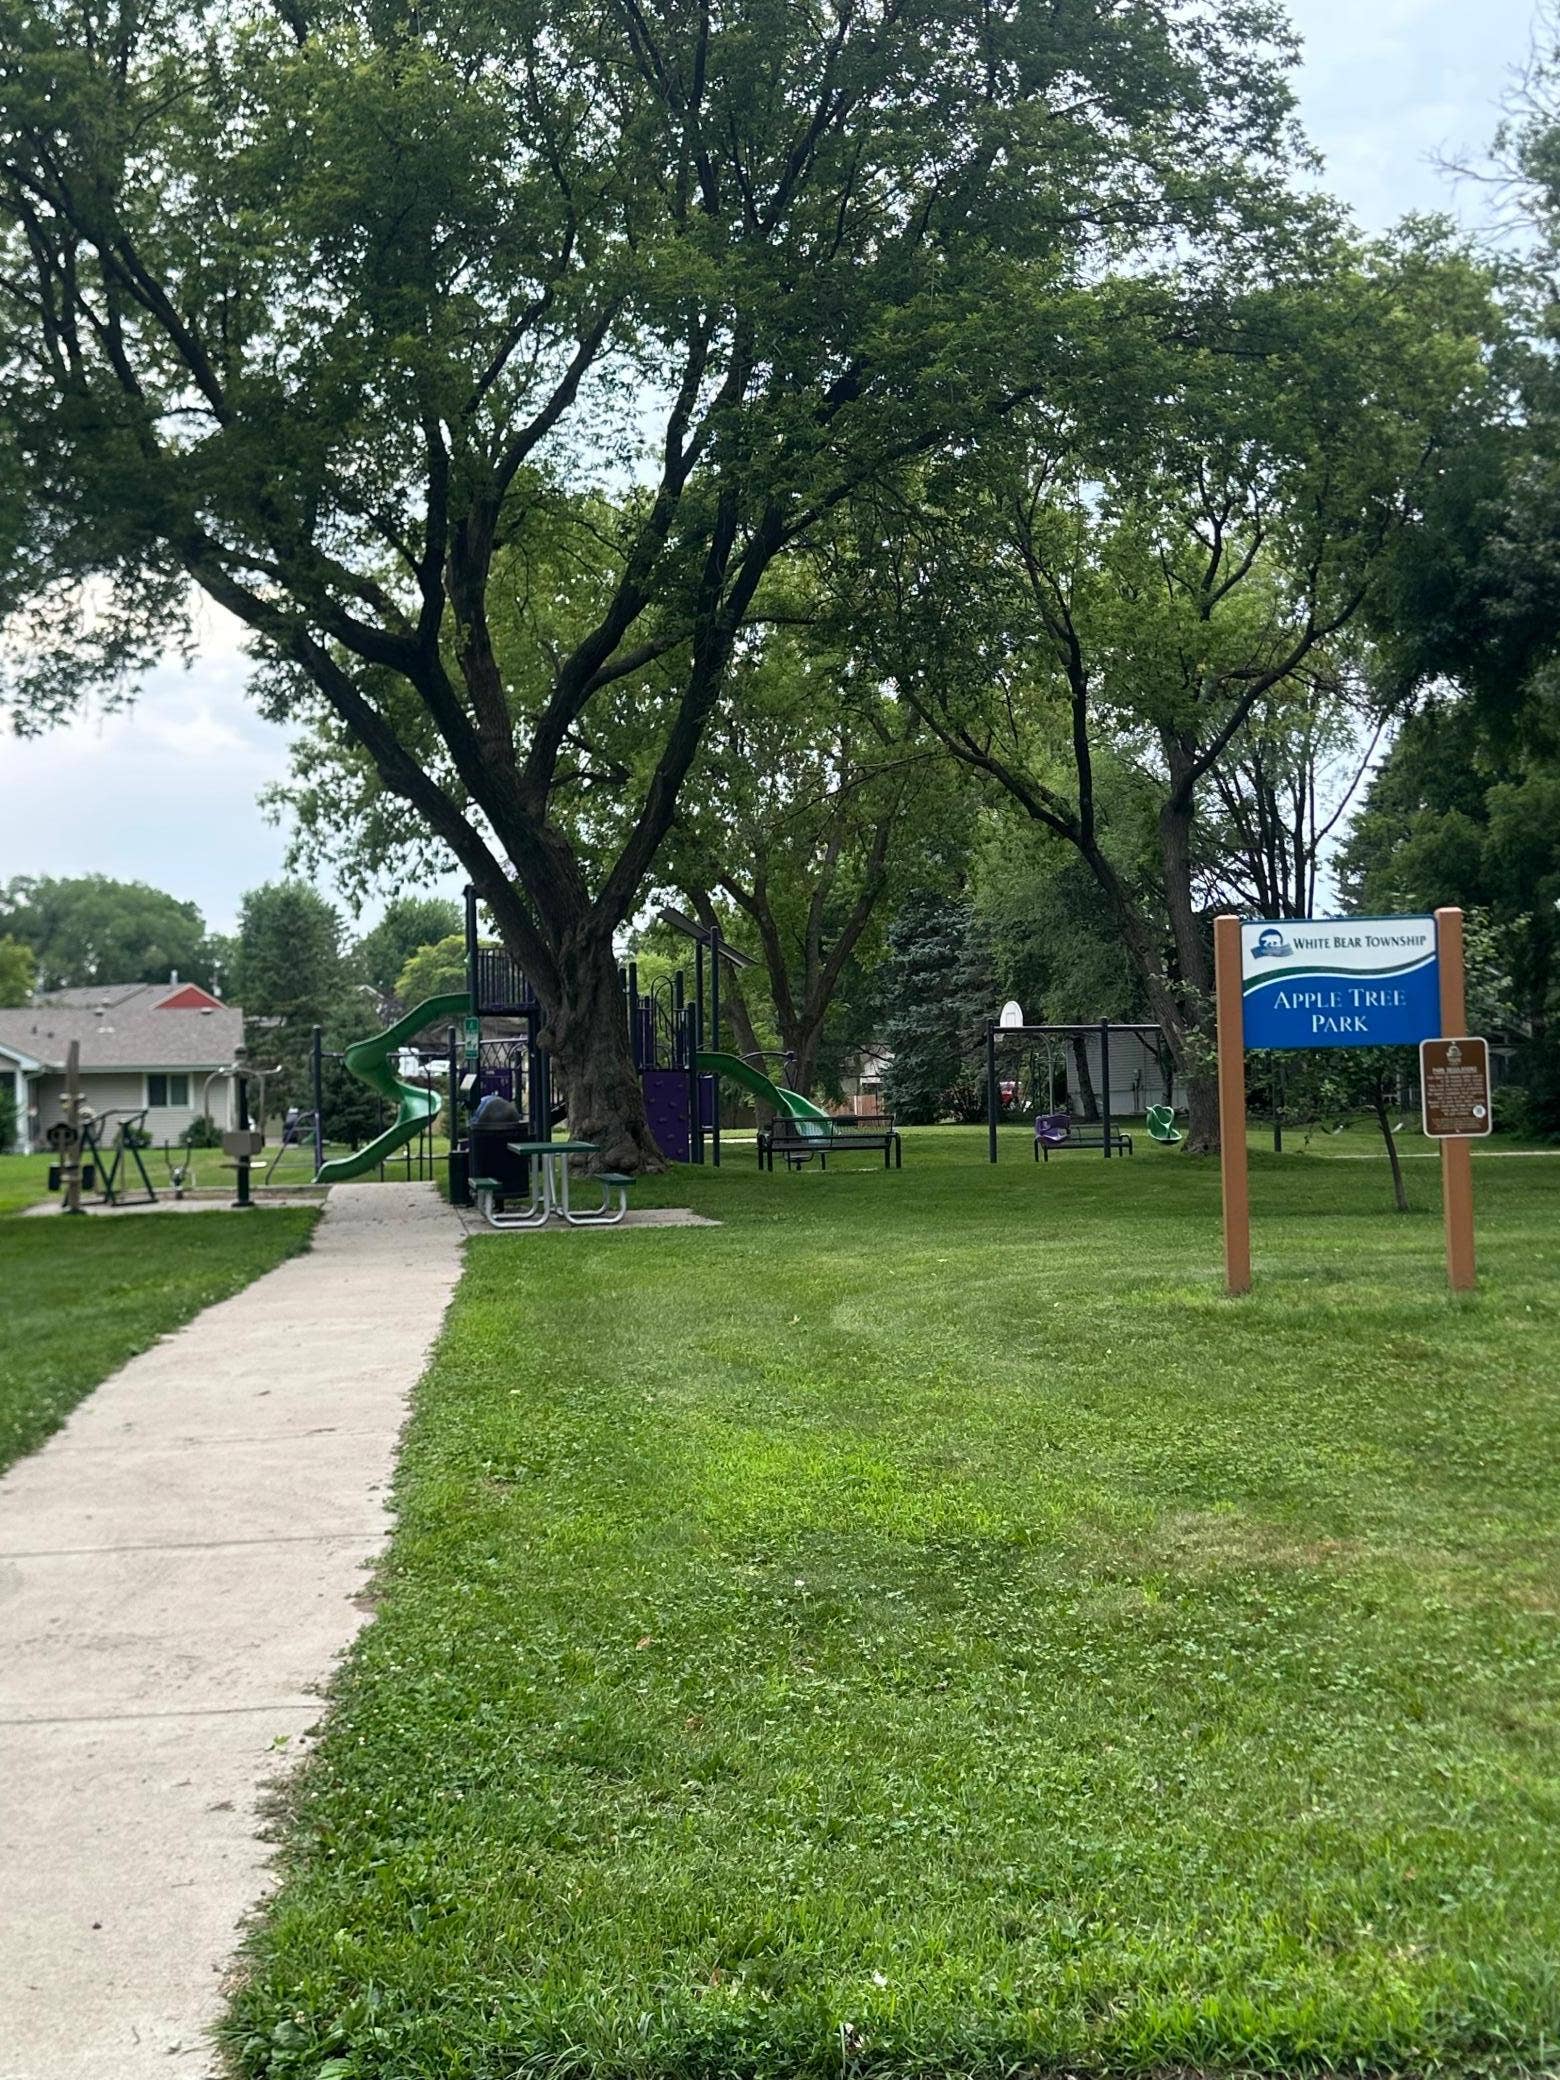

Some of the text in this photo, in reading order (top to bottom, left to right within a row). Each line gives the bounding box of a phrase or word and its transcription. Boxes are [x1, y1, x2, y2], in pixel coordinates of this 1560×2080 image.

[1293, 935, 1427, 950] WHITE BEAR TOWNSHIP
[1274, 988, 1407, 1009] APPLE TREE
[1312, 1014, 1369, 1033] PARK
